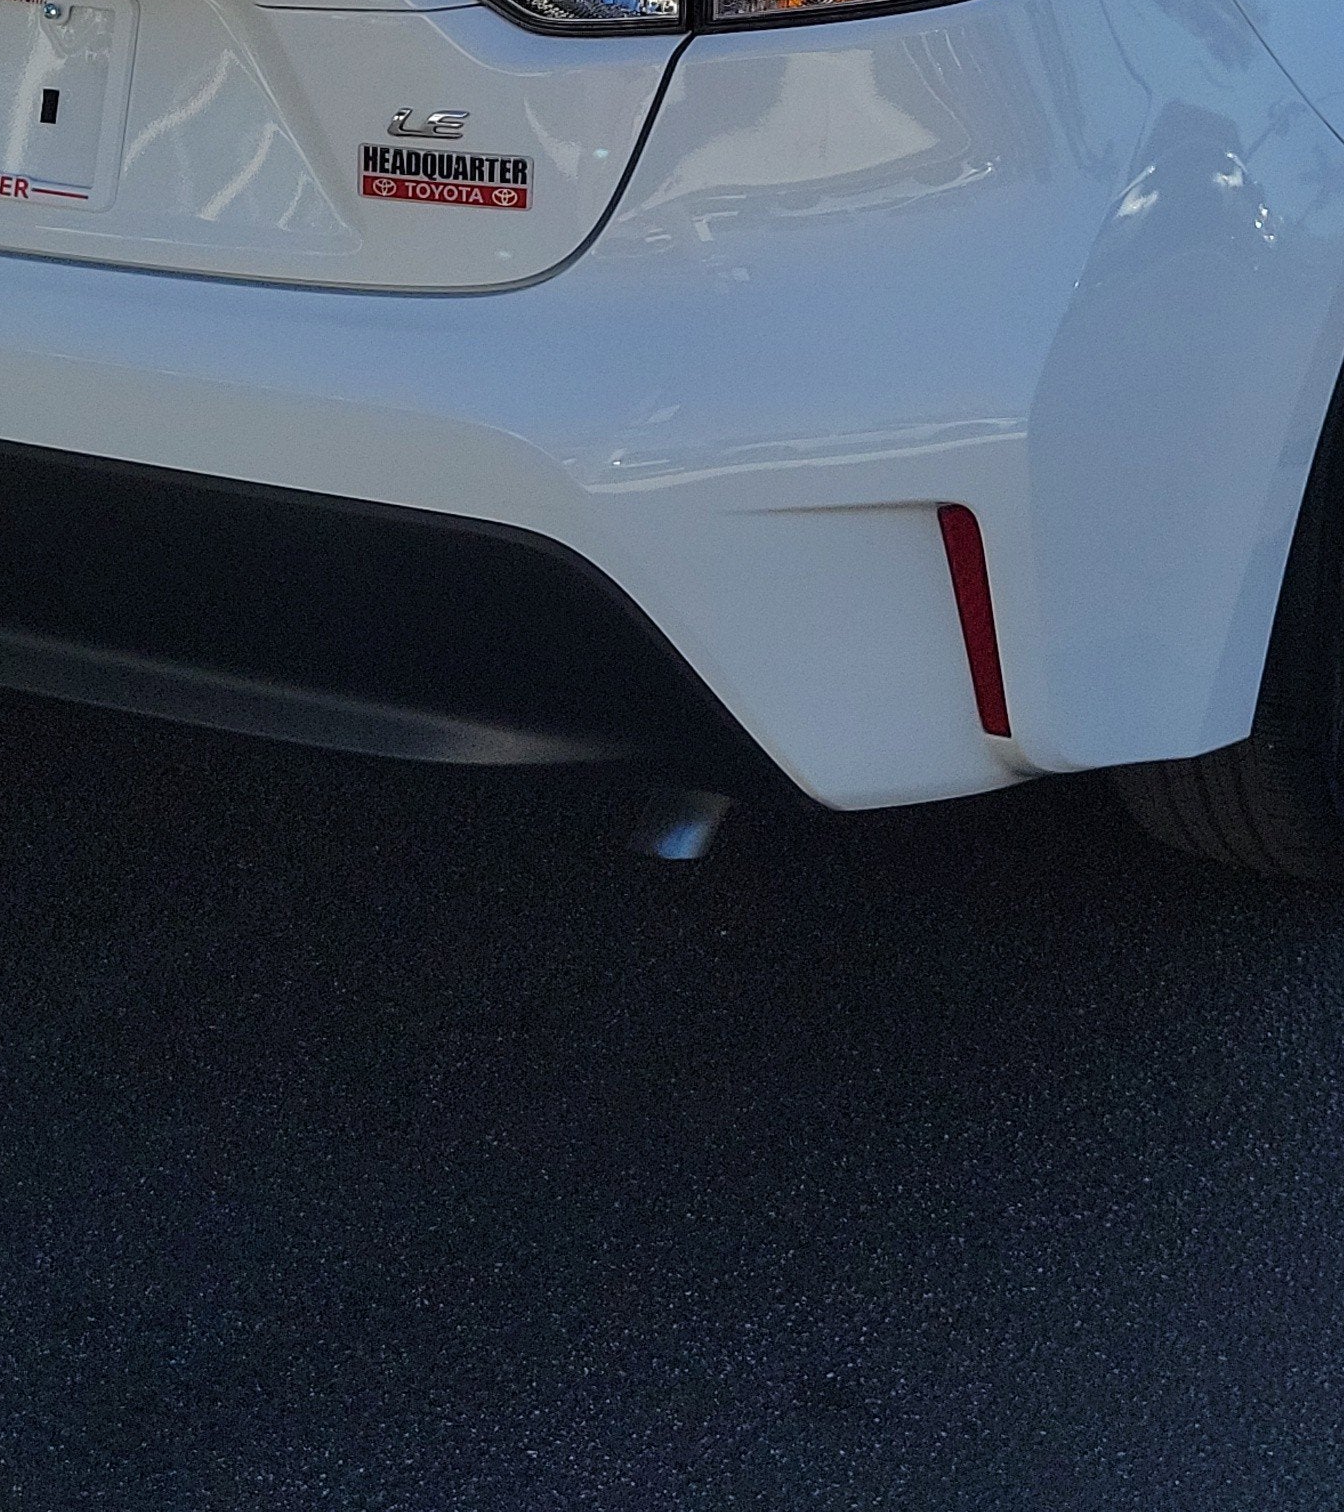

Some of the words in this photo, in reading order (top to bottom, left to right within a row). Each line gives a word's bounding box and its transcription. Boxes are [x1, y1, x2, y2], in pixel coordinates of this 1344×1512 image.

[387, 107, 470, 139] LE
[363, 145, 528, 185] HEADQUARTER
[404, 181, 484, 204] TOYOTA
